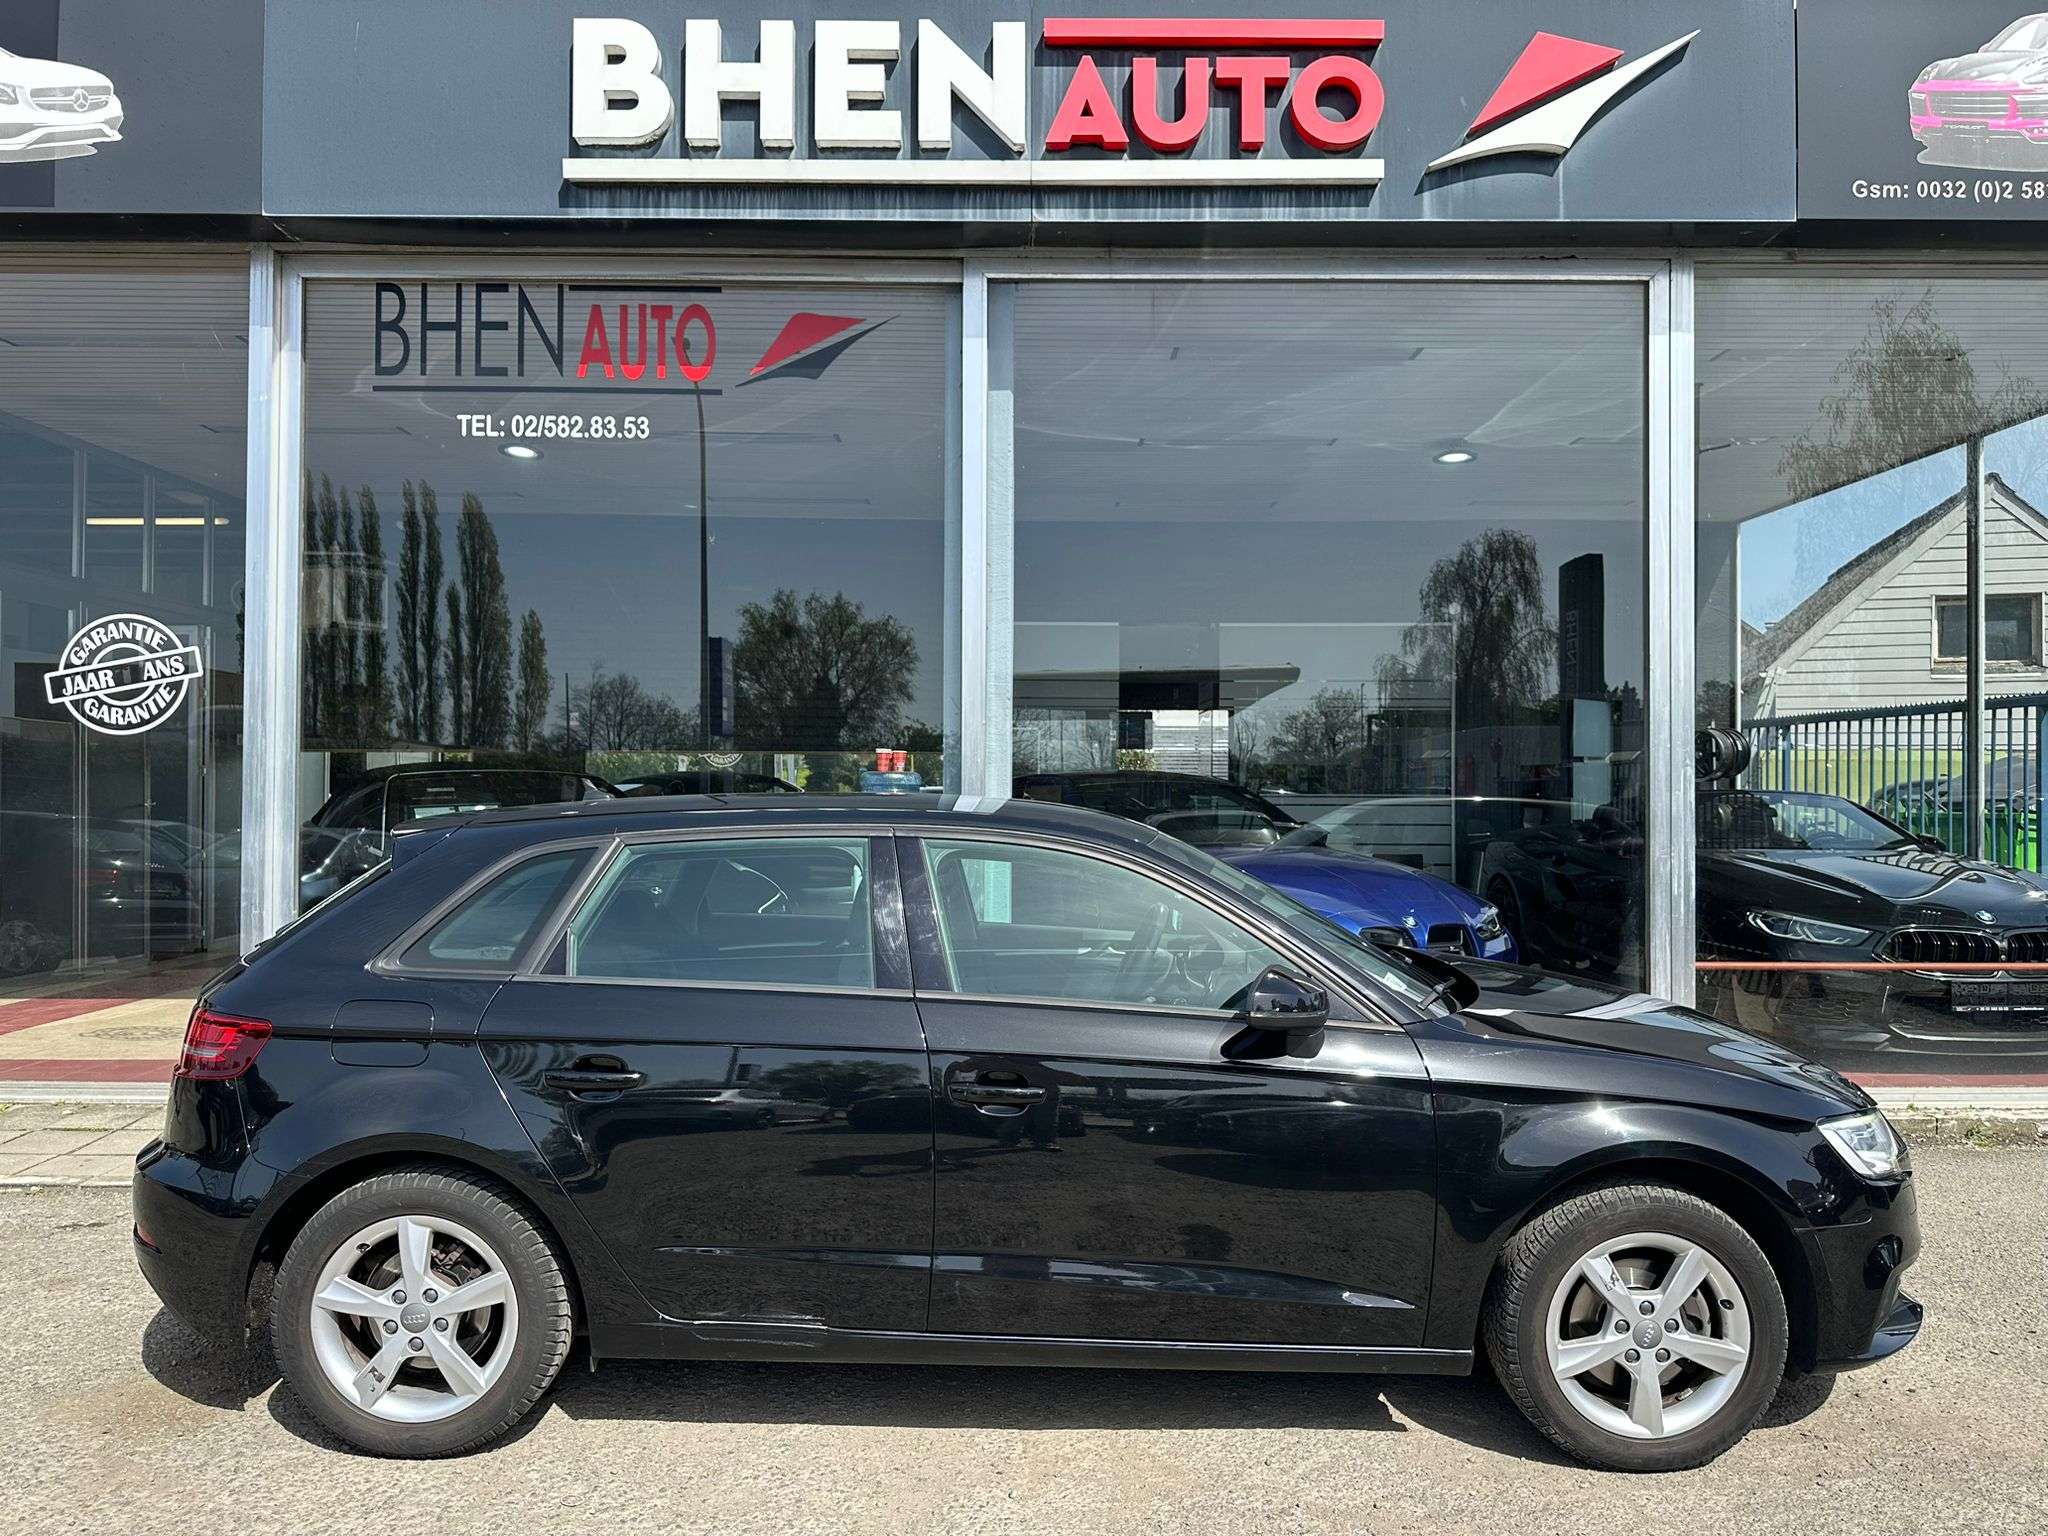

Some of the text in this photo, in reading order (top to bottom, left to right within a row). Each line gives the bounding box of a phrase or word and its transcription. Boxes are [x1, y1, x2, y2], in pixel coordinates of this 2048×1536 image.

[571, 17, 1386, 154] BHEN AUTO
[1852, 180, 1909, 199] Gsm:
[1916, 180, 1967, 199] 0032
[1974, 179, 2014, 203] (0)2
[374, 281, 717, 383] BHEN AUTO
[456, 414, 650, 440] TEL: 02/582.83.53
[69, 621, 168, 666] GARANTIE
[62, 655, 186, 696] JAAR ANS
[83, 684, 177, 726] GARANTIE
